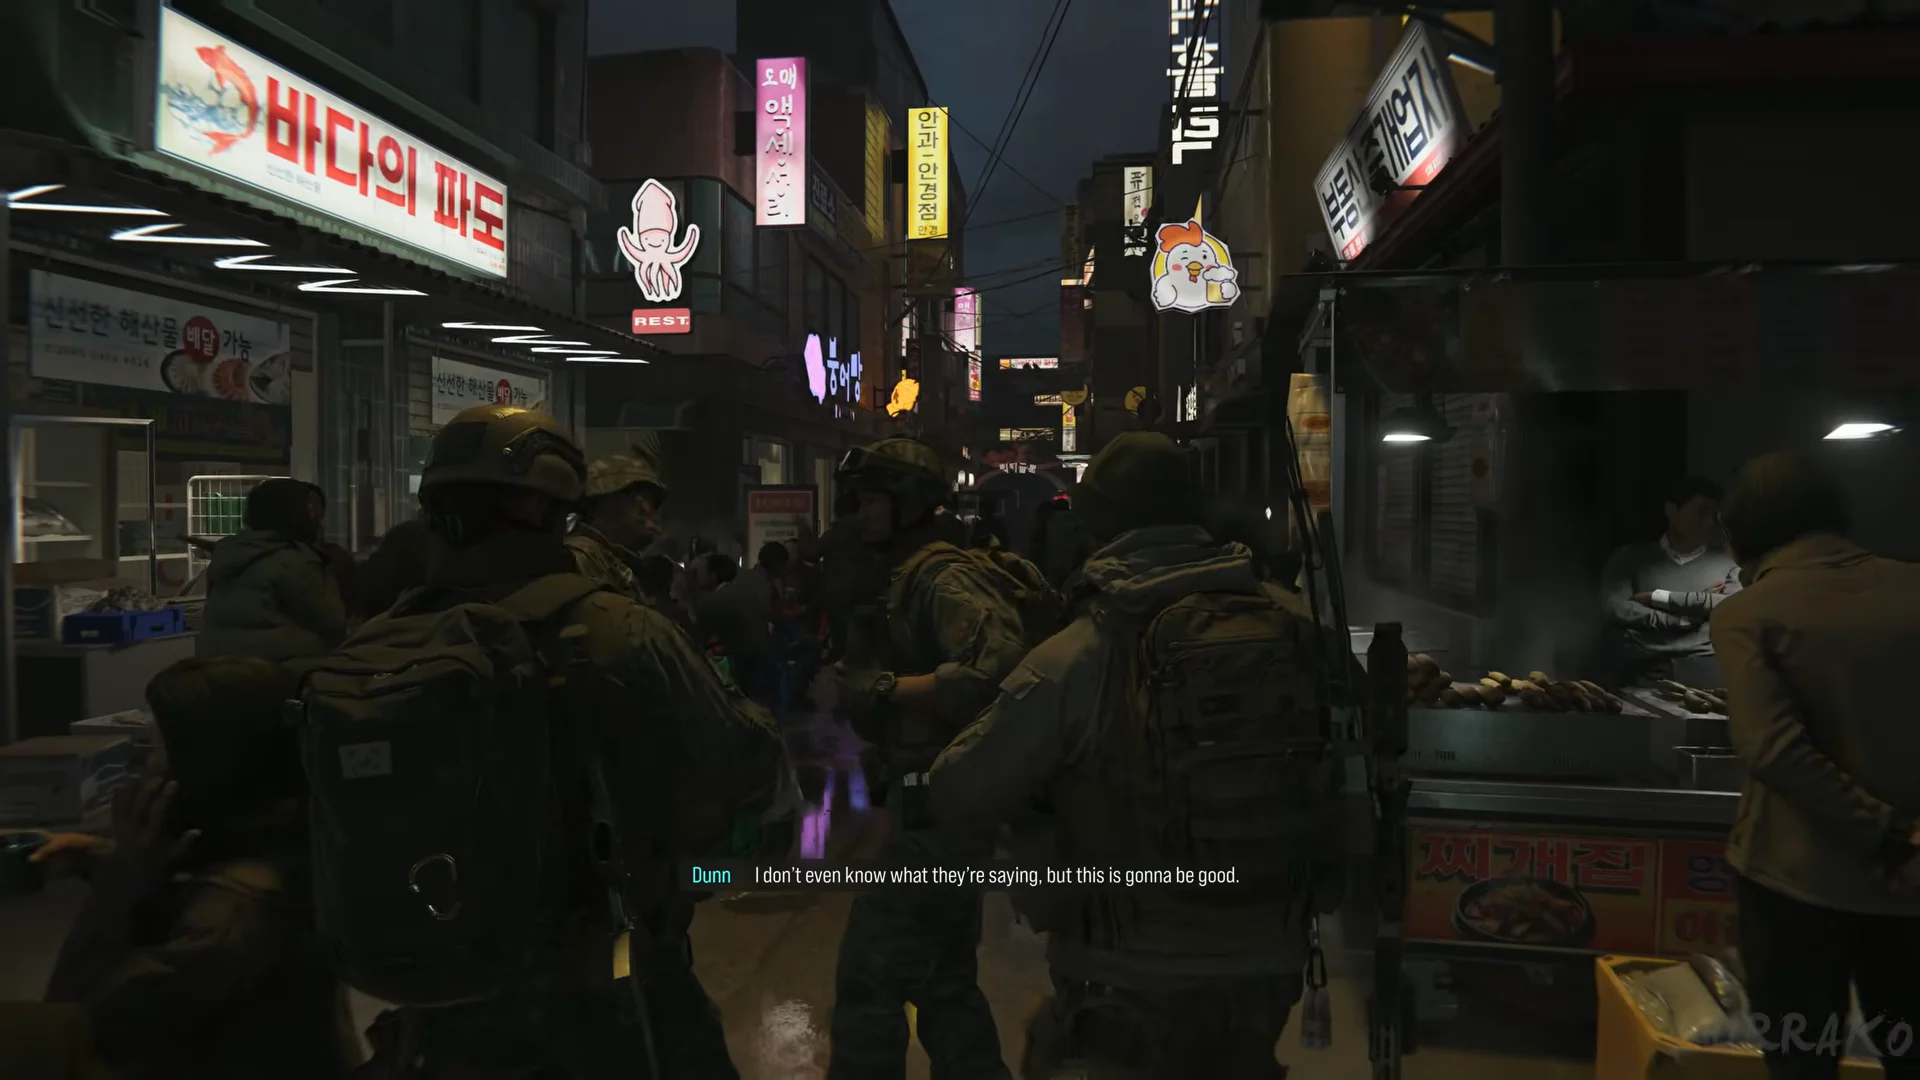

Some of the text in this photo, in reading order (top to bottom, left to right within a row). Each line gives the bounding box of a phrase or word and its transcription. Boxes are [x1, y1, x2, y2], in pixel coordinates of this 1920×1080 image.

[762, 63, 798, 90] 도매
[266, 75, 505, 252] 바다의 파도
[918, 225, 939, 236] 안경
[42, 297, 111, 338] 신선한
[119, 308, 179, 350] 해산물
[186, 326, 216, 357] 배달
[223, 329, 253, 362] 가능
[634, 315, 690, 326] REST.
[437, 371, 465, 397] 신선한
[1418, 835, 1645, 892] 찌개집
